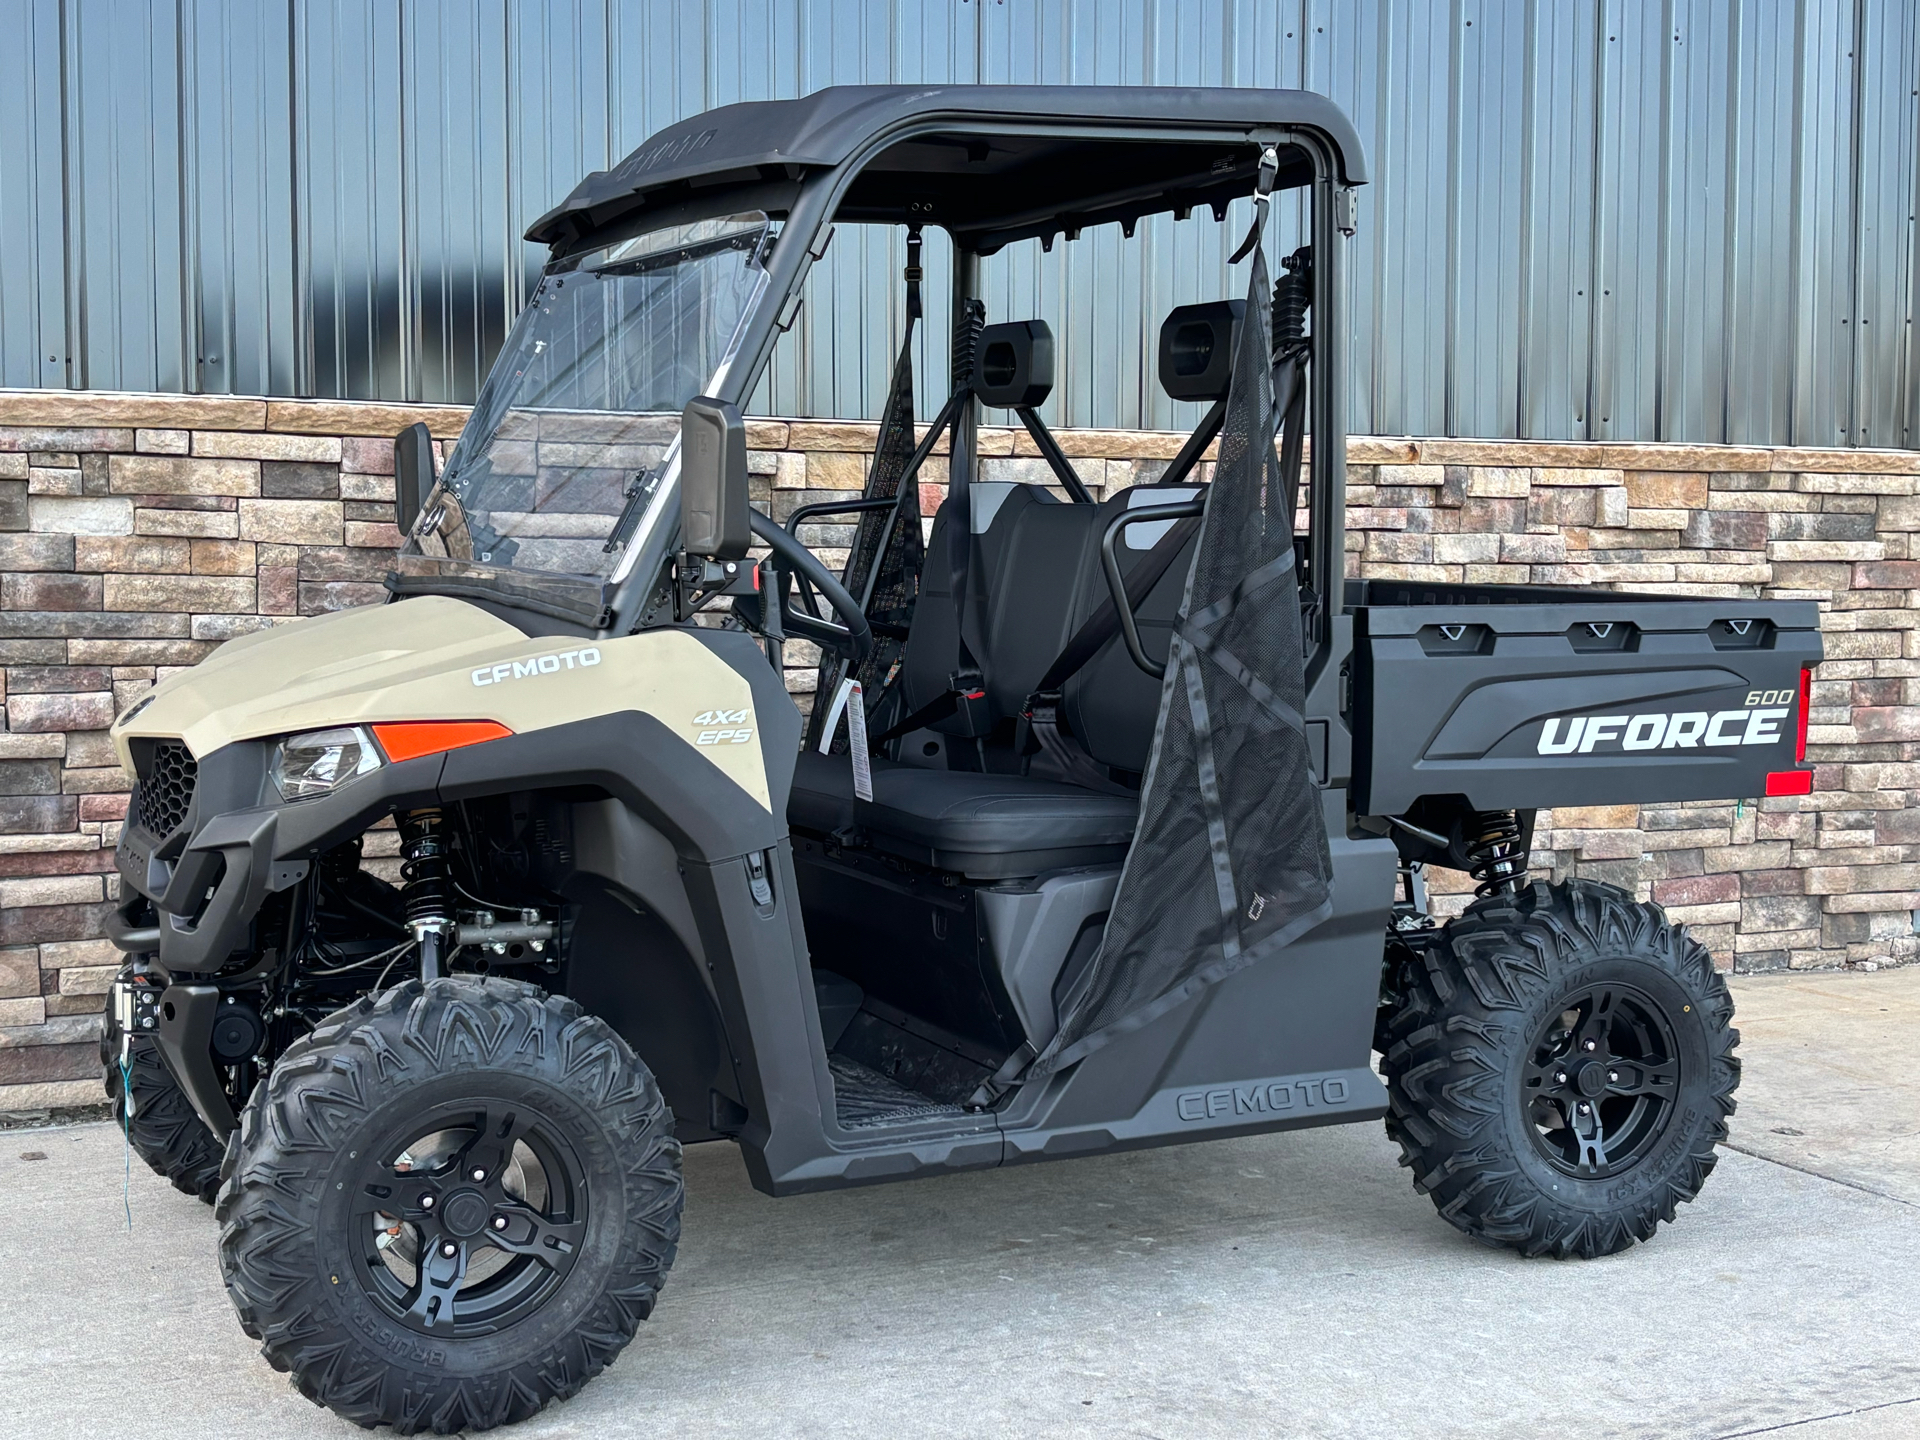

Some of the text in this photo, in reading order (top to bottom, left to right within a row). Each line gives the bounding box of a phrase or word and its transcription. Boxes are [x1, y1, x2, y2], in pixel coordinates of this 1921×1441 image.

[471, 647, 601, 687] CFMOTO
[1744, 689, 1795, 706] 600
[692, 709, 748, 726] 4X4
[1537, 708, 1789, 755] UFORCE
[695, 728, 753, 745] EPS
[1177, 1077, 1350, 1121] CFMOTO
